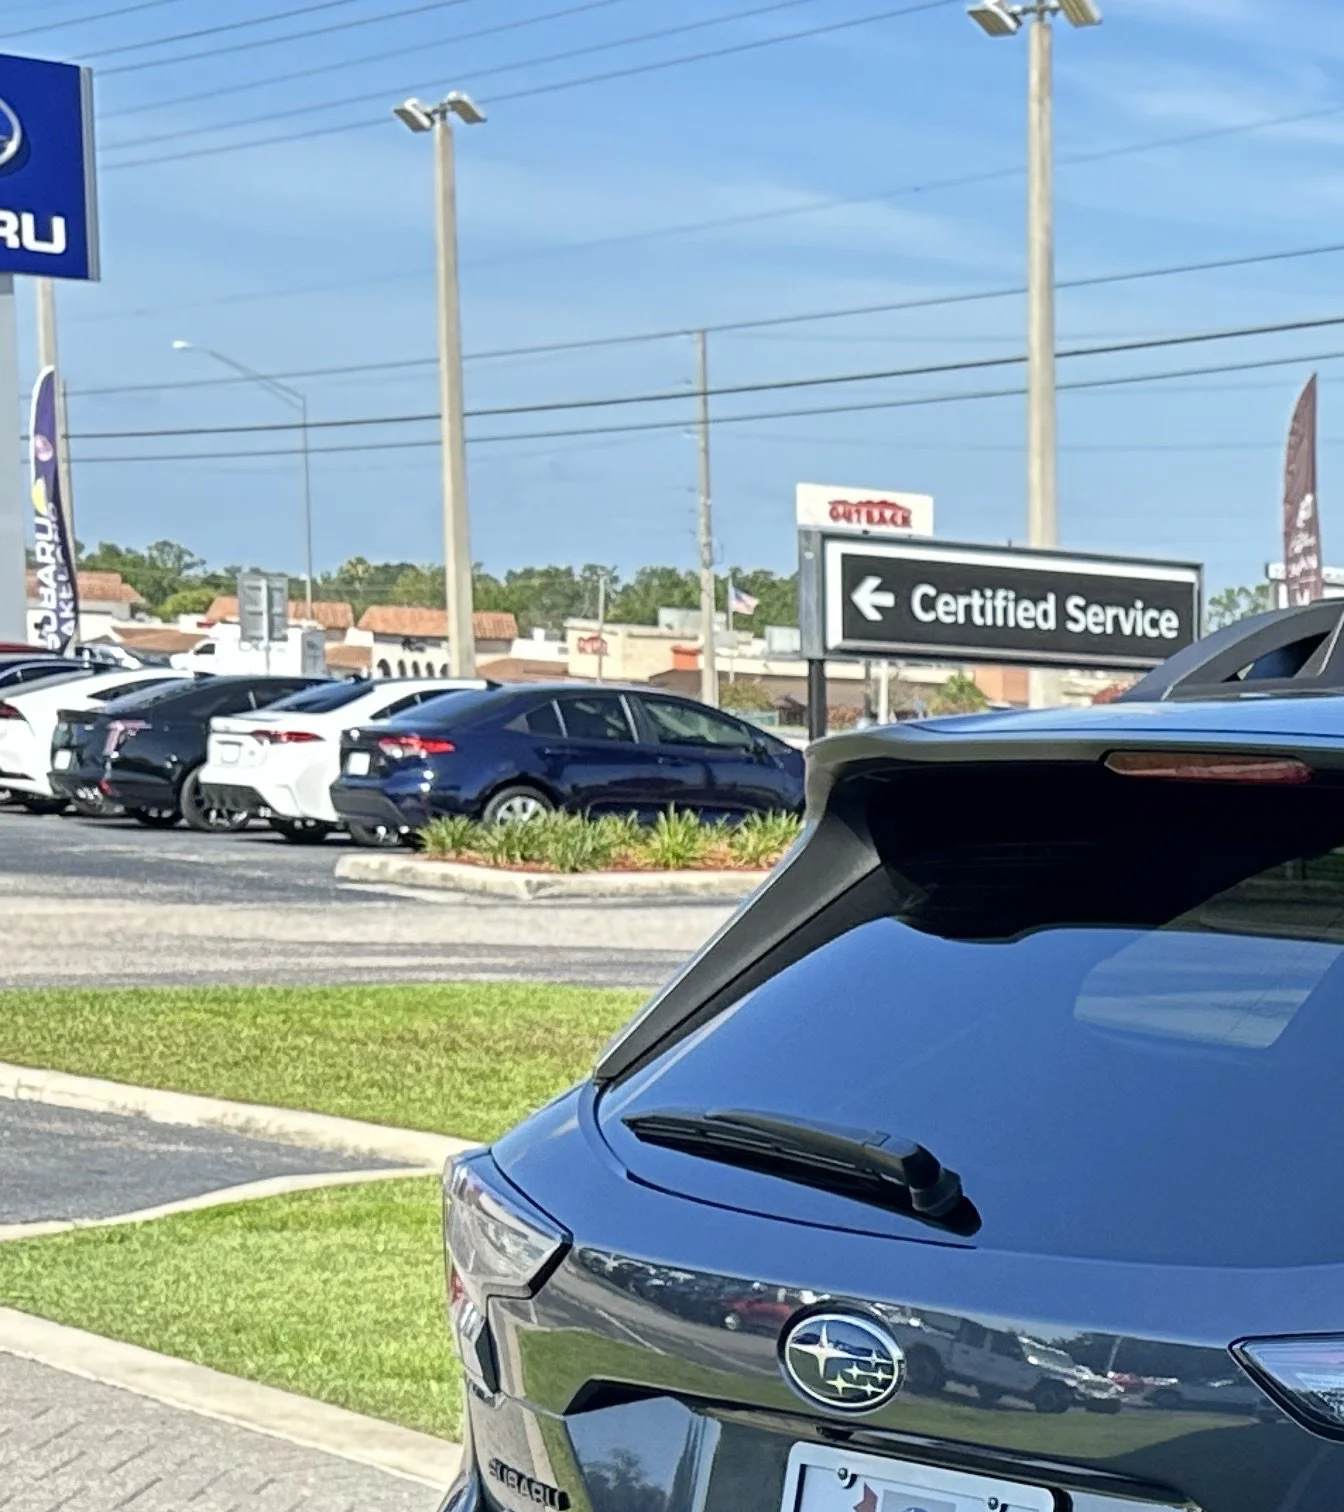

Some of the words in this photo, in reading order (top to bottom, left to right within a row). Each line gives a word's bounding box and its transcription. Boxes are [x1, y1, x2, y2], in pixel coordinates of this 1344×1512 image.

[828, 502, 912, 528] OUTBACK
[910, 583, 1057, 631] Certified
[1064, 595, 1180, 639] Service
[488, 1457, 571, 1512] SUBARU
